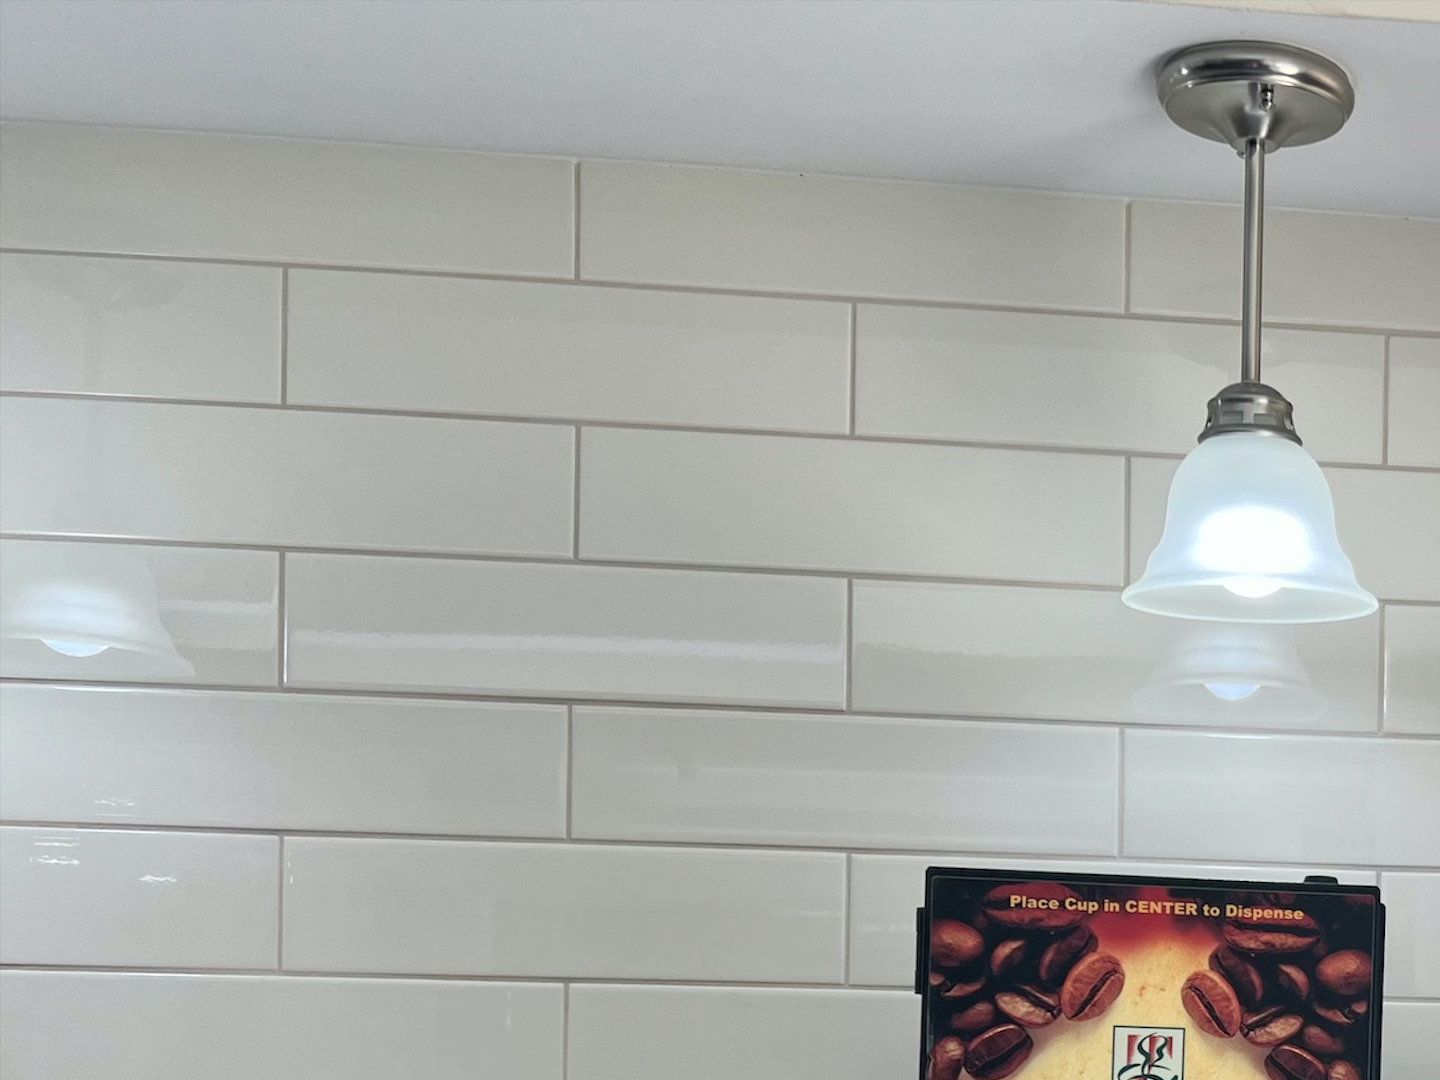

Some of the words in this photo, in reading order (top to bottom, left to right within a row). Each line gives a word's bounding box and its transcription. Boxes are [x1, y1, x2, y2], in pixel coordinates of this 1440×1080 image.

[1009, 895, 1059, 909] Place
[1065, 898, 1099, 913] Cup
[1104, 898, 1120, 912] in
[1125, 900, 1197, 916] CENTER
[1203, 904, 1221, 917] to
[1225, 905, 1304, 920] Dispense
